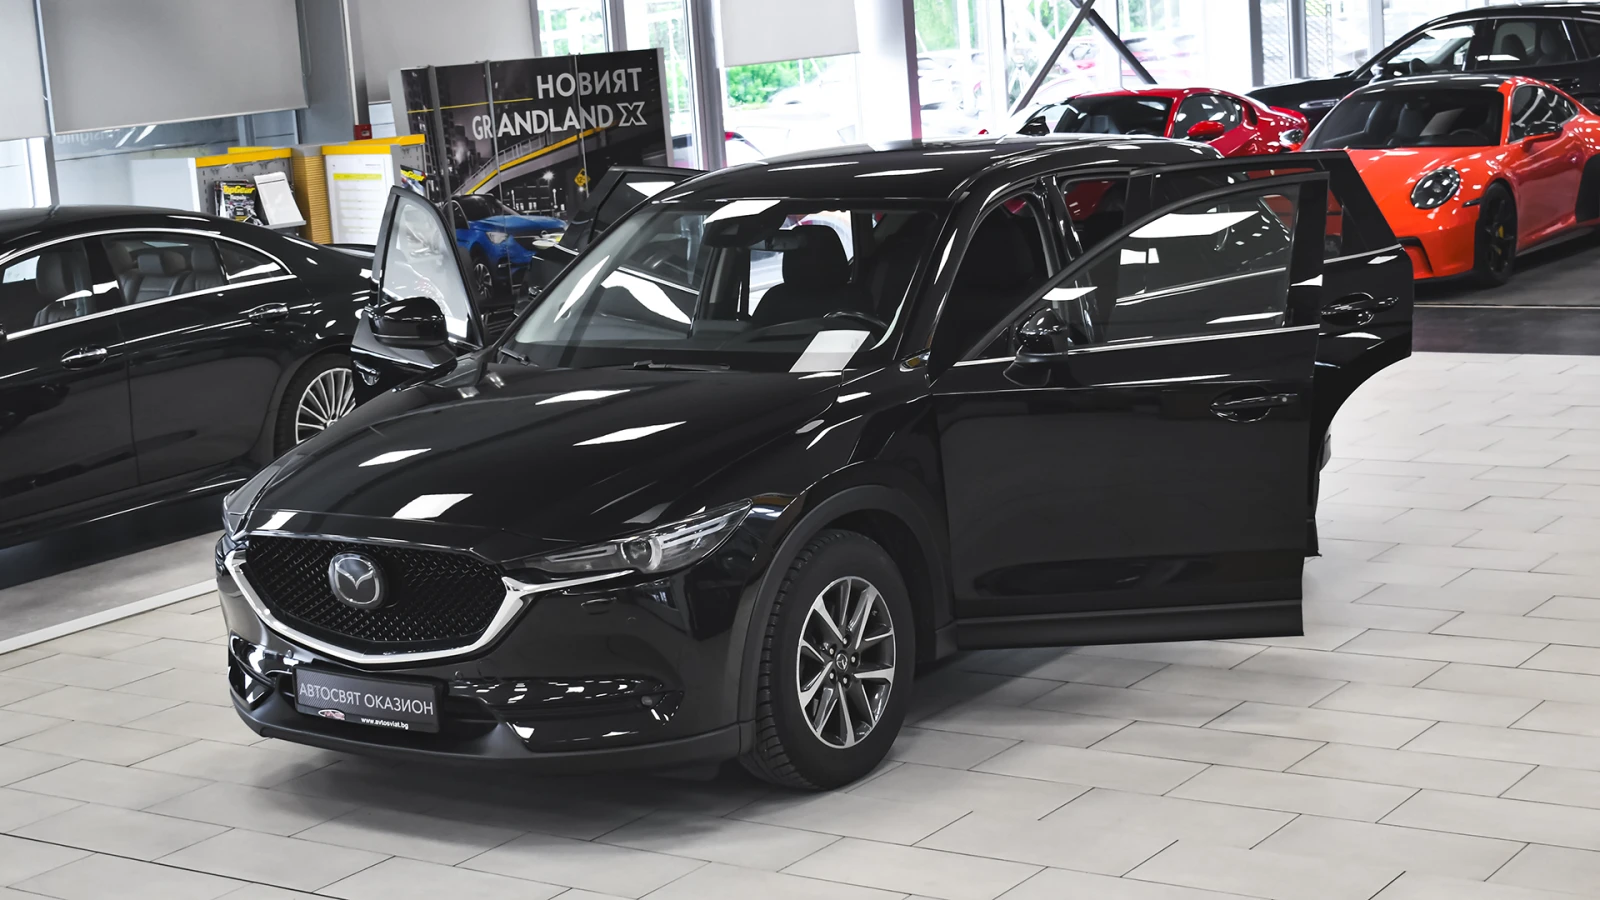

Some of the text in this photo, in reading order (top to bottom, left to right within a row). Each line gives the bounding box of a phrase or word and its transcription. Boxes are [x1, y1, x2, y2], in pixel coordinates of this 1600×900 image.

[536, 67, 642, 99] НОВИЯТ
[472, 101, 648, 141] GRANDLAND X
[223, 185, 256, 195] TopGear
[299, 682, 434, 716] АВТОСВЯТ ОКАЗИОН
[360, 717, 409, 730] www.avtosviat.bg
